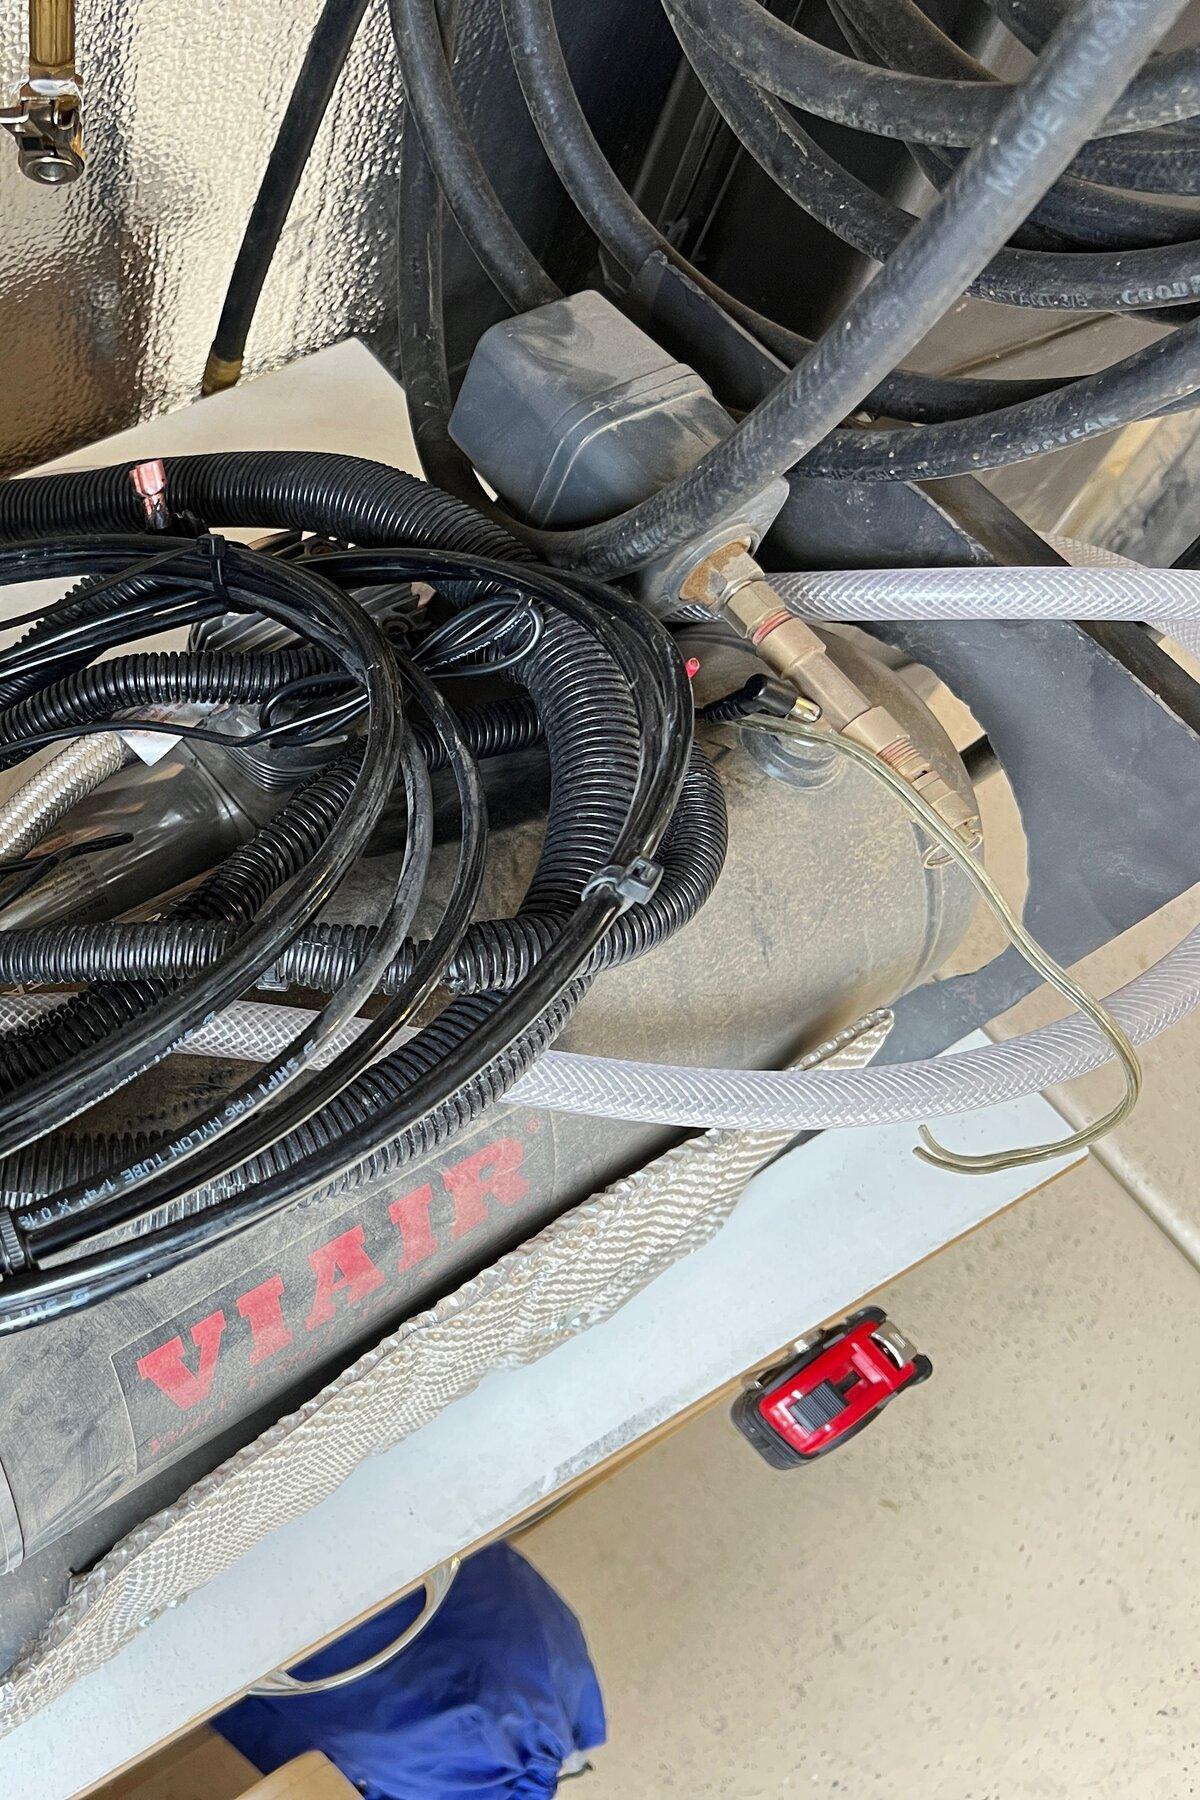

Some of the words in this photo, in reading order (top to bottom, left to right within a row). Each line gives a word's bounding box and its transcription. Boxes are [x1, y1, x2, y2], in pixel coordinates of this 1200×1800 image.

[257, 1056, 301, 1096] SHPI
[222, 1092, 256, 1122] PA6
[167, 1114, 222, 1158] NYLON
[119, 1149, 166, 1185] TUBE
[55, 1197, 71, 1212] X
[135, 1132, 532, 1411] VIAIR
